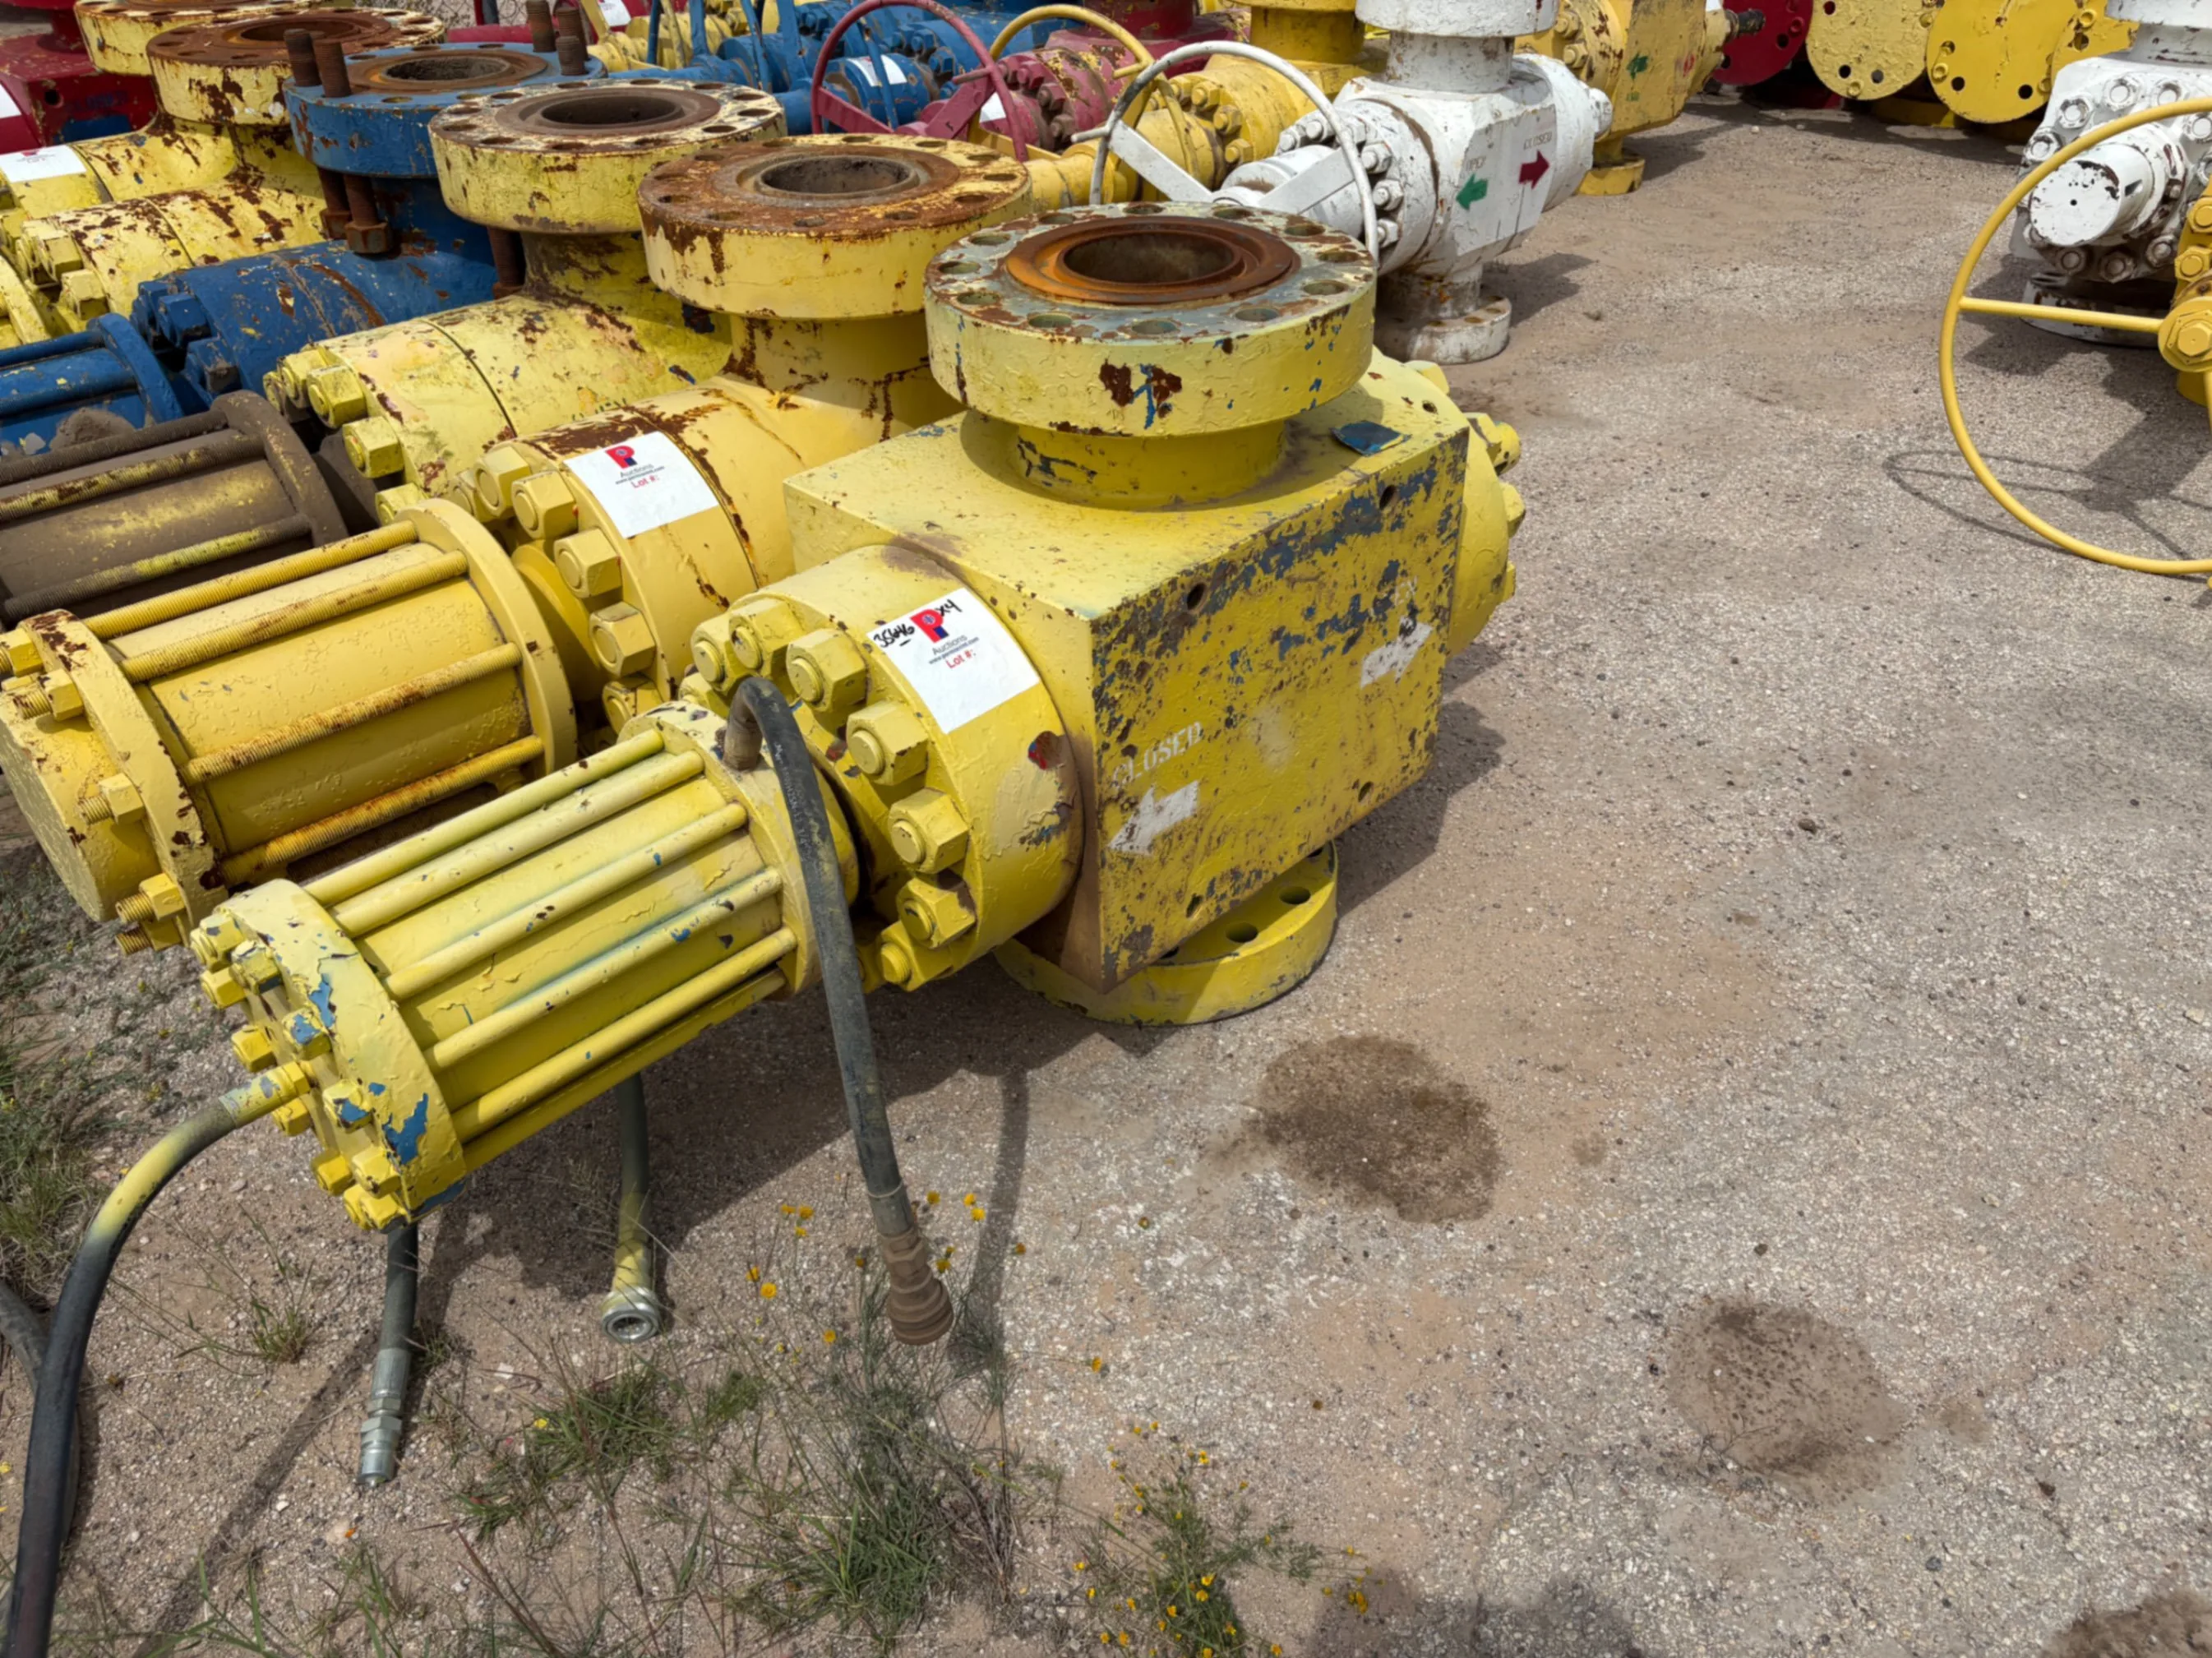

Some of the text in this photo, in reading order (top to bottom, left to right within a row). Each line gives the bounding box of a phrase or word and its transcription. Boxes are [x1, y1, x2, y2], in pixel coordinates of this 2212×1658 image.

[630, 477, 649, 489] Lot
[931, 634, 968, 656] Auctions
[945, 655, 966, 670] Lot
